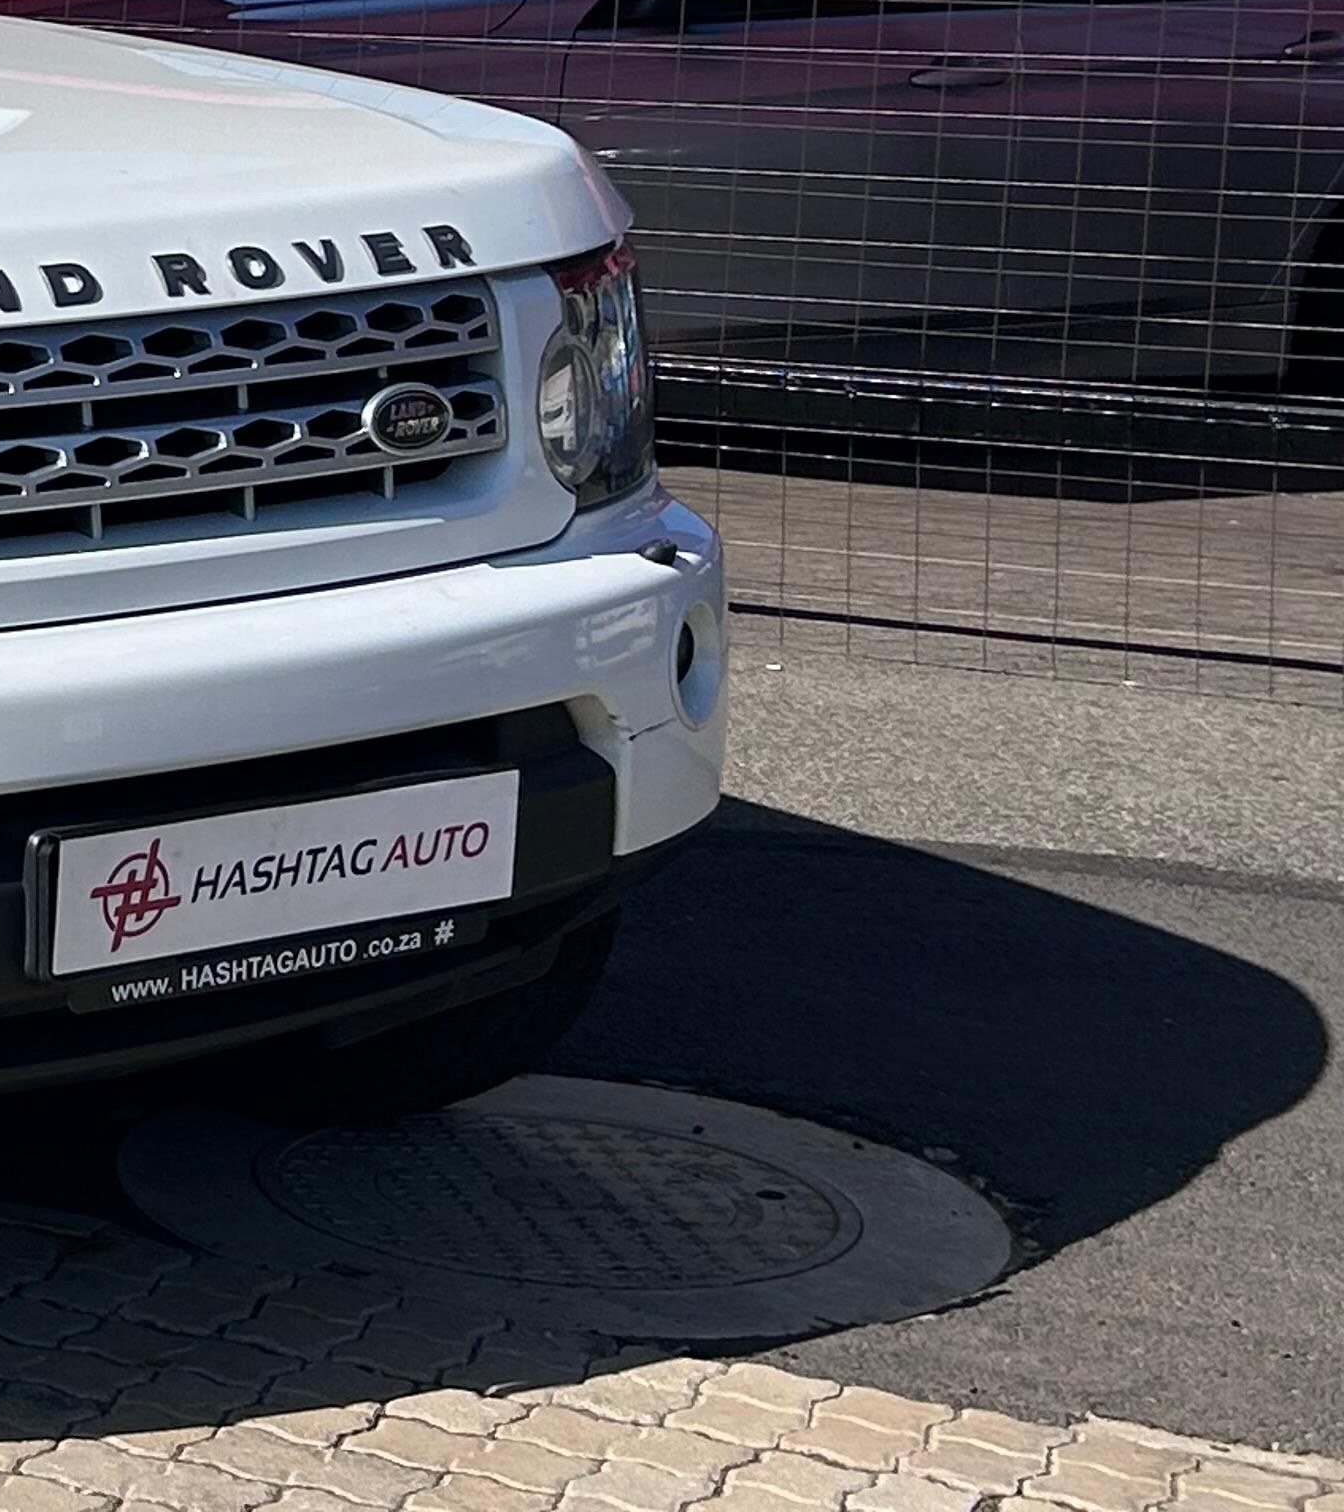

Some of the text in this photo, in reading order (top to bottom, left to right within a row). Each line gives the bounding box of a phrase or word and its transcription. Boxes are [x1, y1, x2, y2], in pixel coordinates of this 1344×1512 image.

[150, 222, 478, 298] ROVER
[192, 821, 489, 905] HASHTAG AUTO
[111, 975, 174, 1003] www.
[181, 940, 358, 991] HASHTAGAUTO
[362, 931, 422, 960] .co.za
